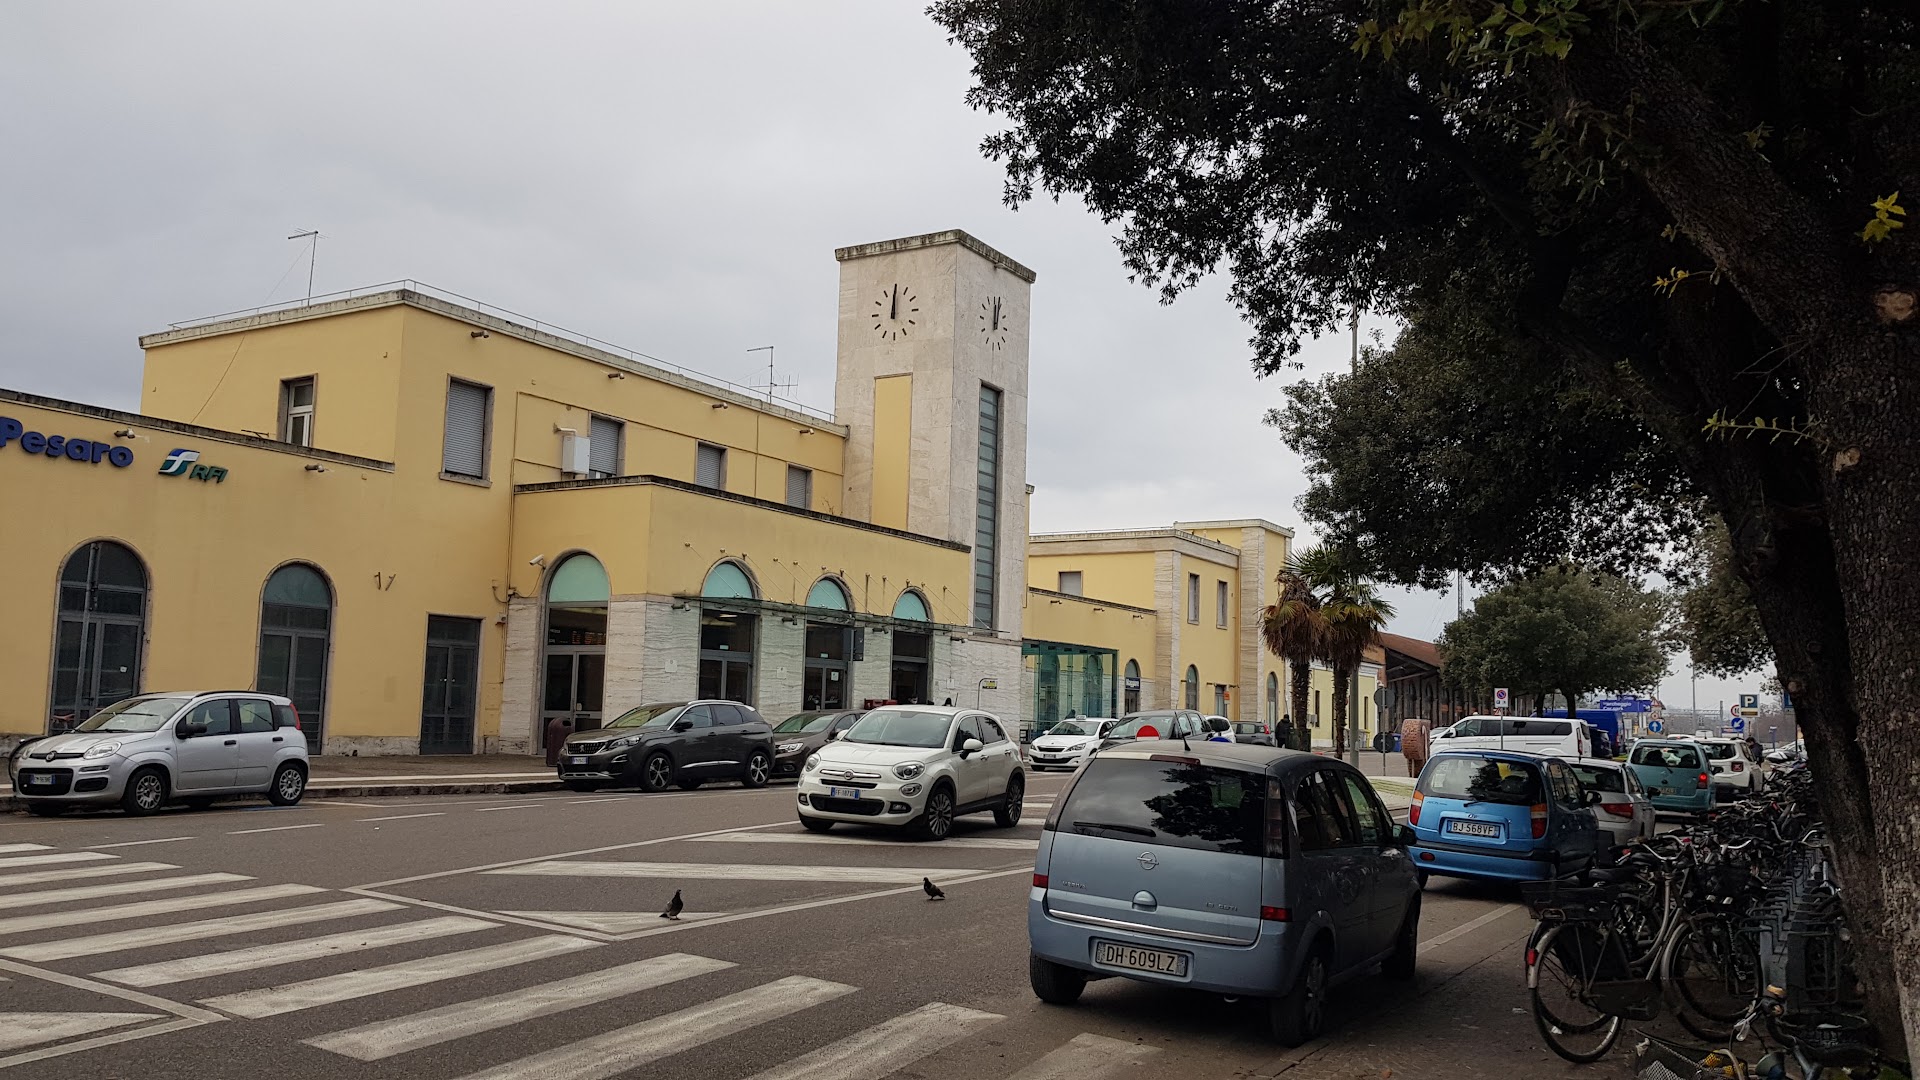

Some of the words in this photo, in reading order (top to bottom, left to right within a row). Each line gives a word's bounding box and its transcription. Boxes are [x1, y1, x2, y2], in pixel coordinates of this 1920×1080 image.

[0, 416, 134, 467] Pesaro
[189, 464, 229, 483] RFI
[1745, 696, 1754, 707] P
